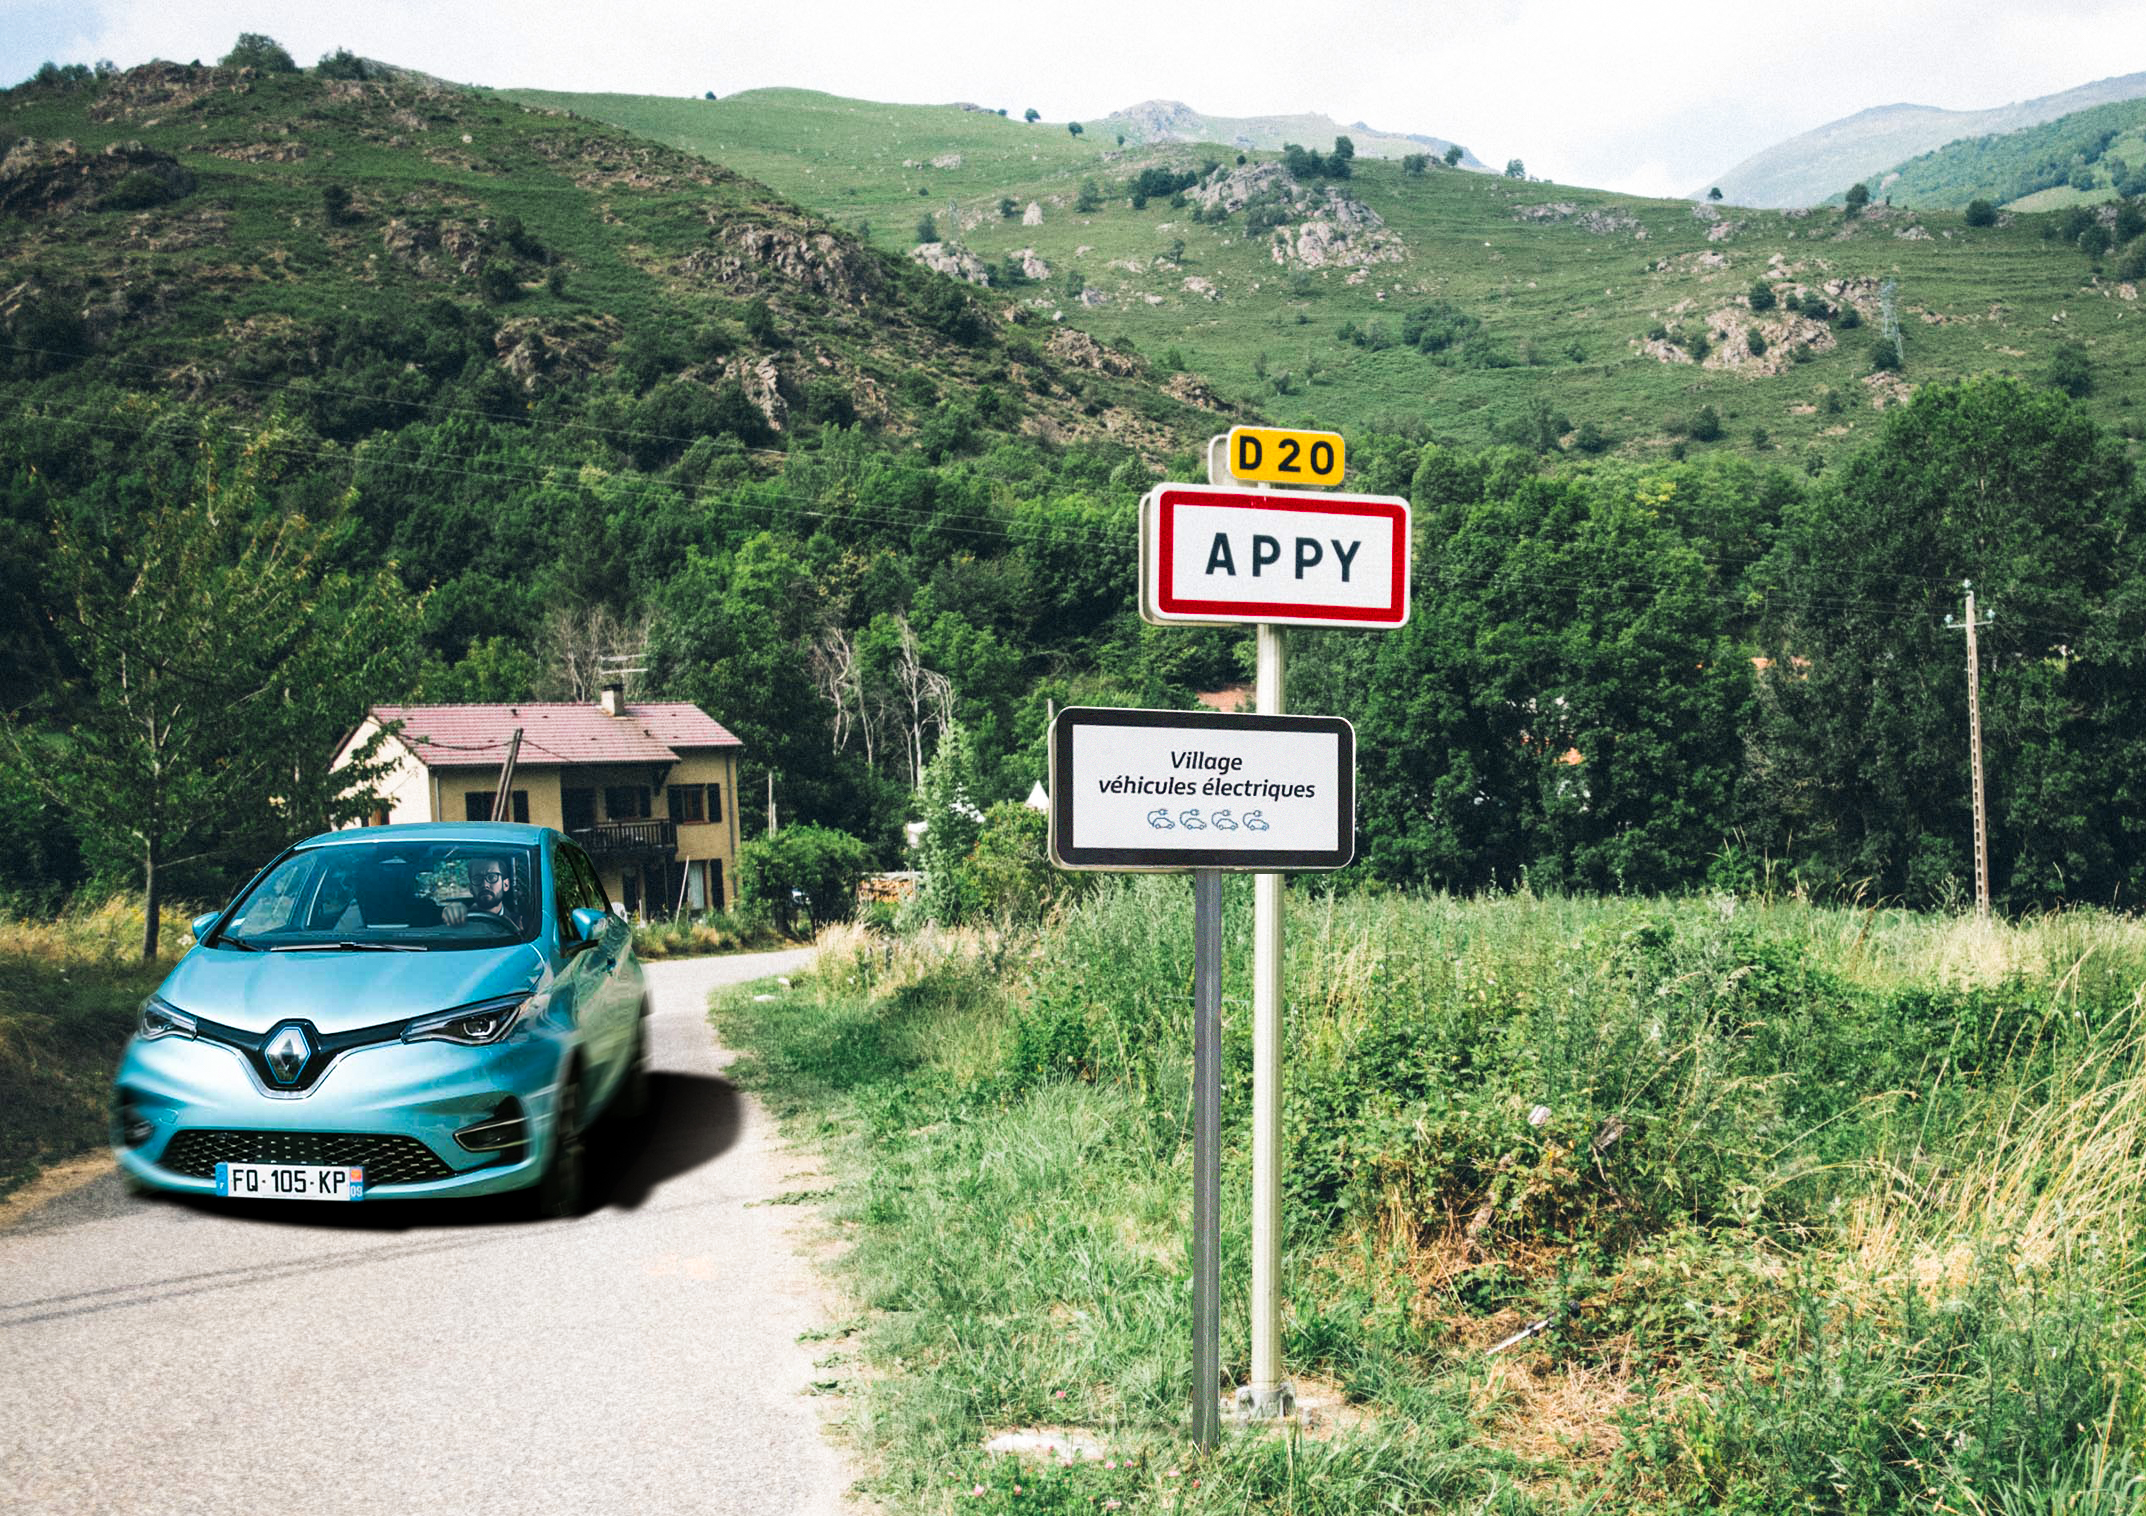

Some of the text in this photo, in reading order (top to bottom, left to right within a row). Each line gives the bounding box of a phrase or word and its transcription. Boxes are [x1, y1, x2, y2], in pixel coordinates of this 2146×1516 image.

[1239, 436, 1334, 475] D 20
[1205, 532, 1362, 582] APPY
[1170, 751, 1243, 775] Village
[1098, 775, 1316, 802] véhicules électriques
[351, 1185, 363, 1198] 09
